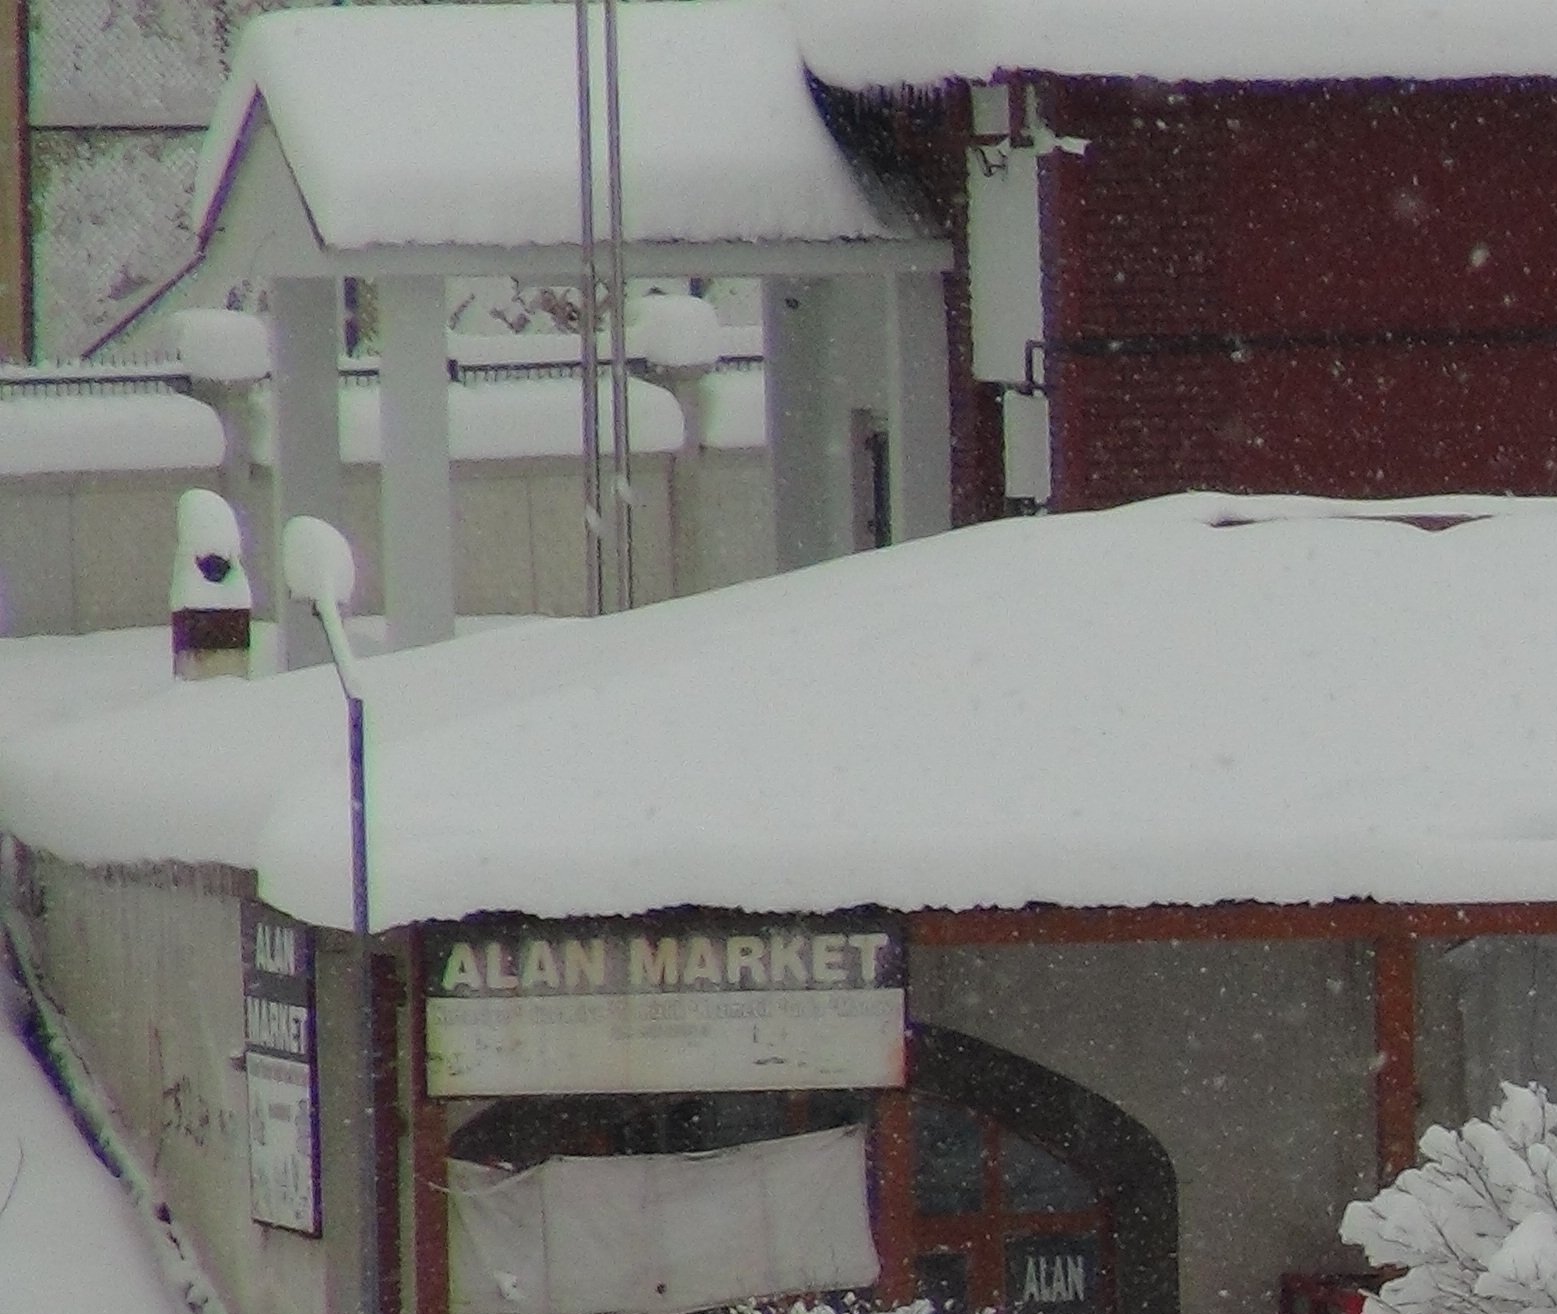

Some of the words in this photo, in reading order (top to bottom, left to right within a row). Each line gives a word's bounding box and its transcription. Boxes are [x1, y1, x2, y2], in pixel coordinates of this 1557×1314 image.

[255, 921, 296, 977] ALAN
[442, 937, 604, 992] ALAN
[627, 931, 890, 987] MARKET
[246, 995, 308, 1056] MARKET
[1022, 1254, 1086, 1303] ALAN
